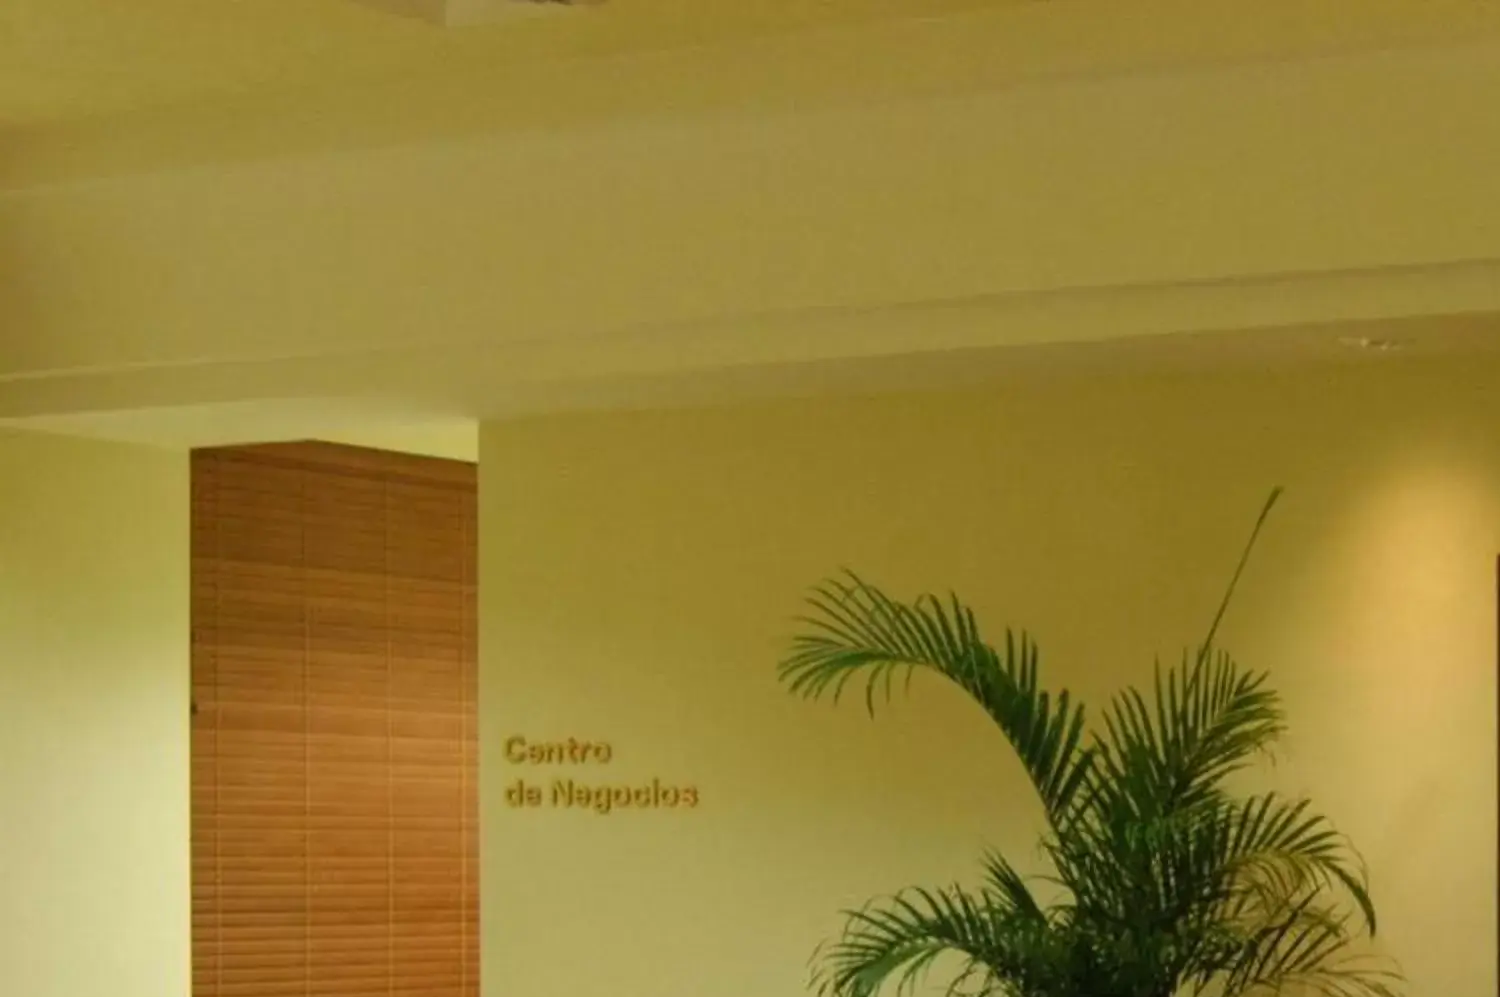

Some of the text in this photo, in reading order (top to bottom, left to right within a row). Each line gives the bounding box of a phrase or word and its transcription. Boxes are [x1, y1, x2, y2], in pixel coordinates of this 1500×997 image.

[505, 734, 612, 764] Centro
[505, 777, 699, 814] de Negocios
